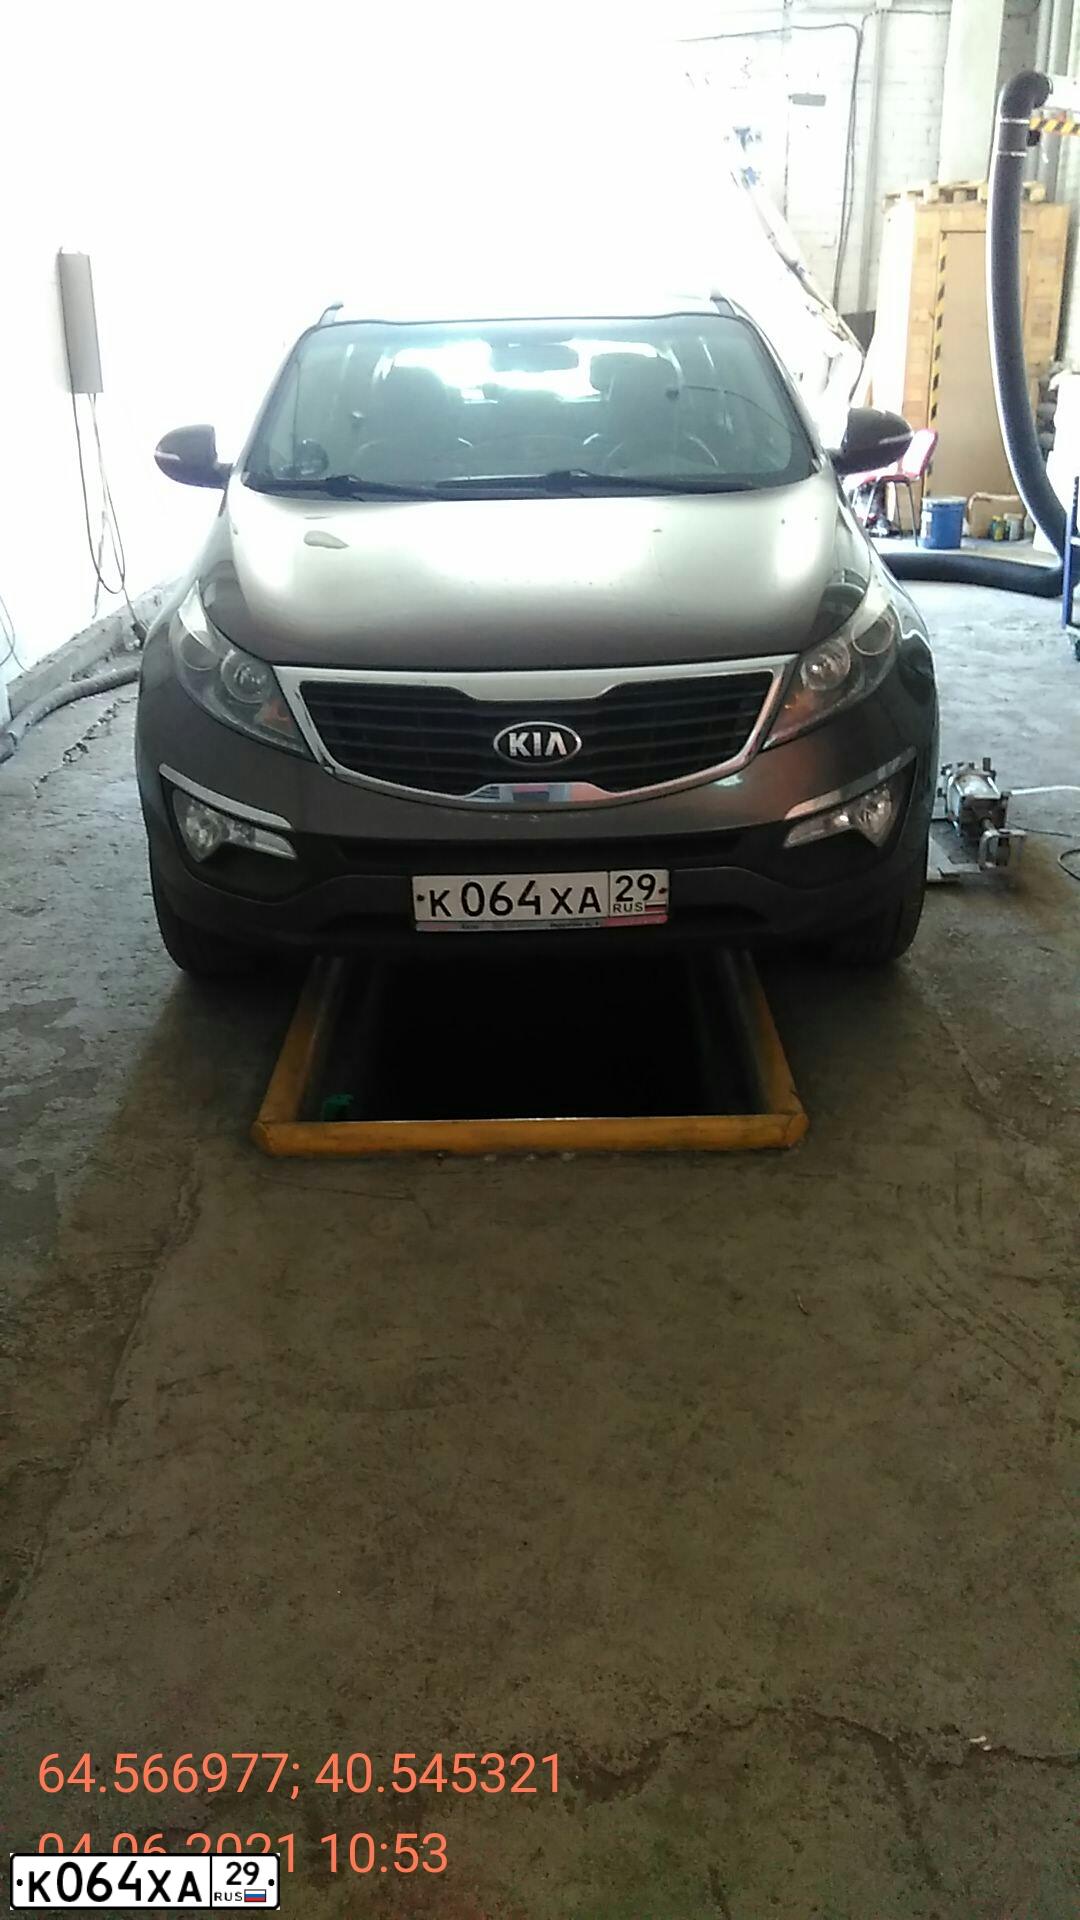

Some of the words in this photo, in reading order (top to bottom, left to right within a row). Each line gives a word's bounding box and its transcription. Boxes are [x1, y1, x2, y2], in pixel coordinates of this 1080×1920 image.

[508, 732, 567, 757] KIA
[615, 873, 656, 902] 29
[613, 902, 644, 913] RUS
